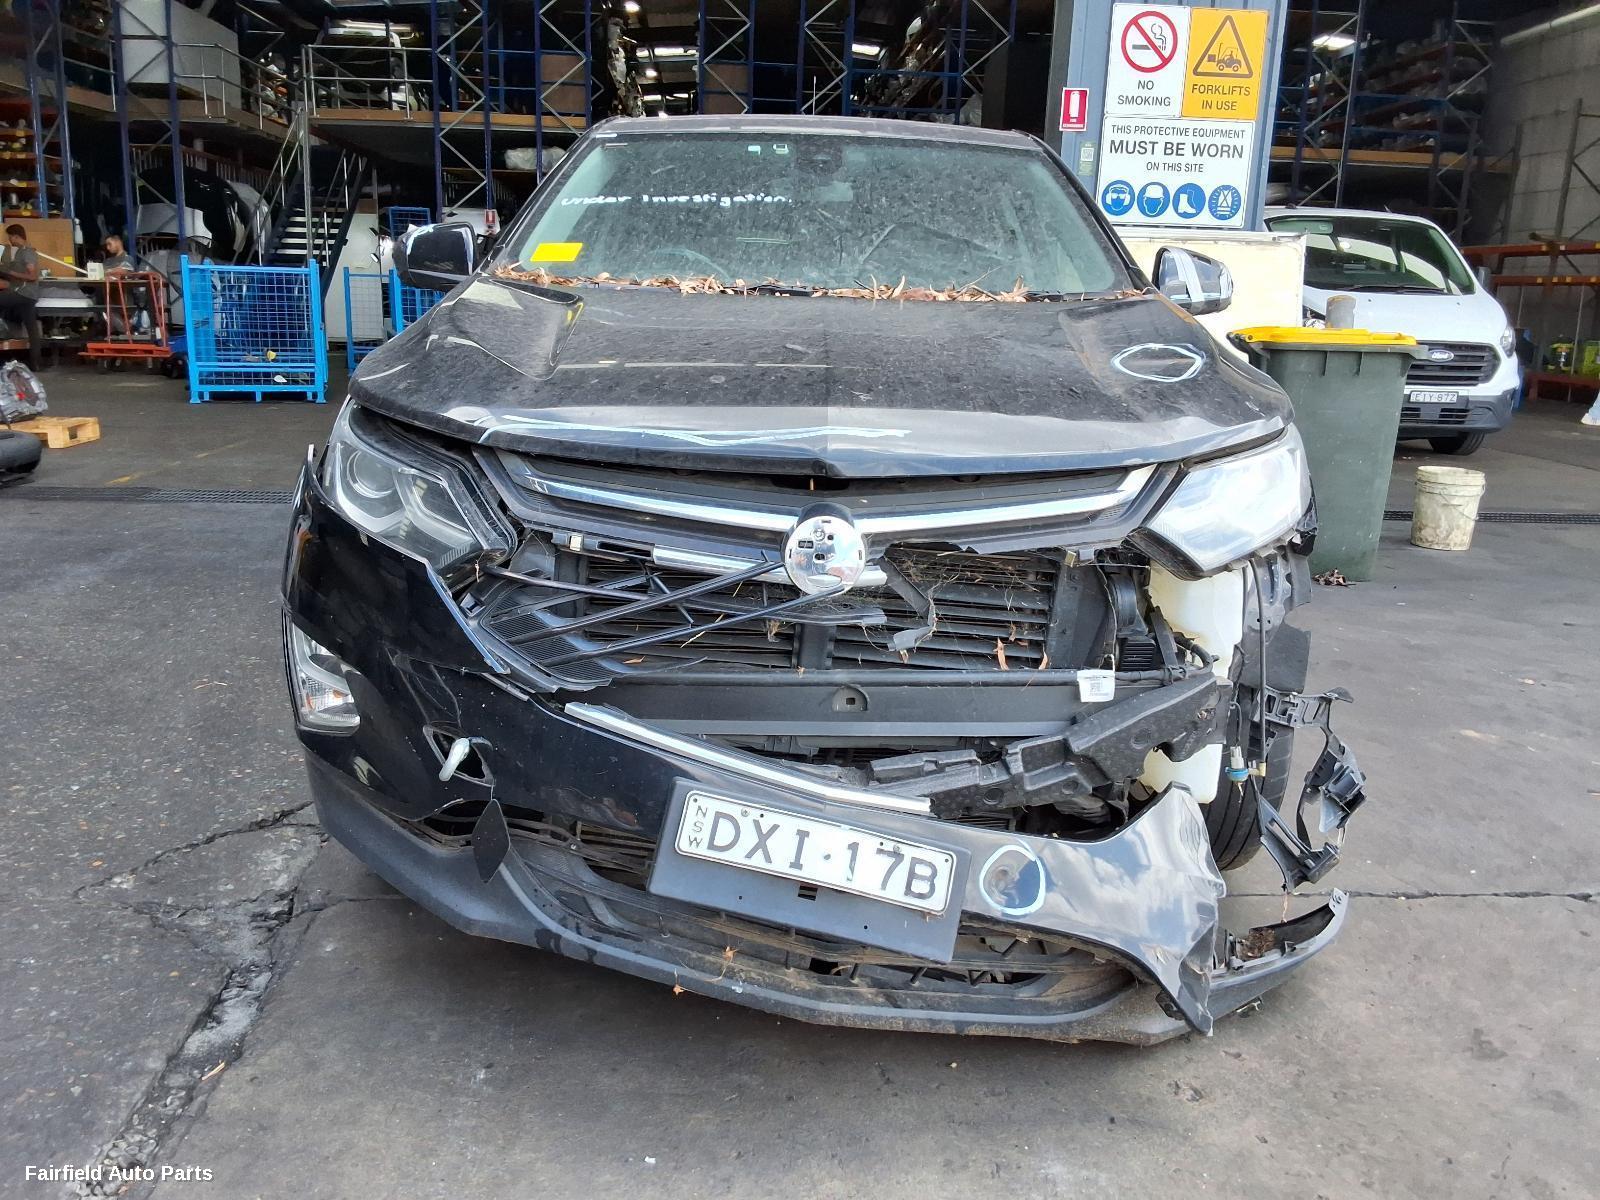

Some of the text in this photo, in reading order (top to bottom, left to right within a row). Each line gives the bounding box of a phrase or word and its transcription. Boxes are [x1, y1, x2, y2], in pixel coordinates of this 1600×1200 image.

[1137, 79, 1155, 91] NO
[1191, 83, 1251, 97] FORKLIFTS
[1117, 94, 1171, 107] SMOKING
[1201, 100, 1237, 111] IN USE
[1111, 124, 1246, 139] THIS PROTECTIVE EQUIPMENT
[1109, 139, 1244, 158] MUST BE WORN
[1146, 161, 1204, 173] ON THIS SITE
[688, 804, 709, 850] NSW
